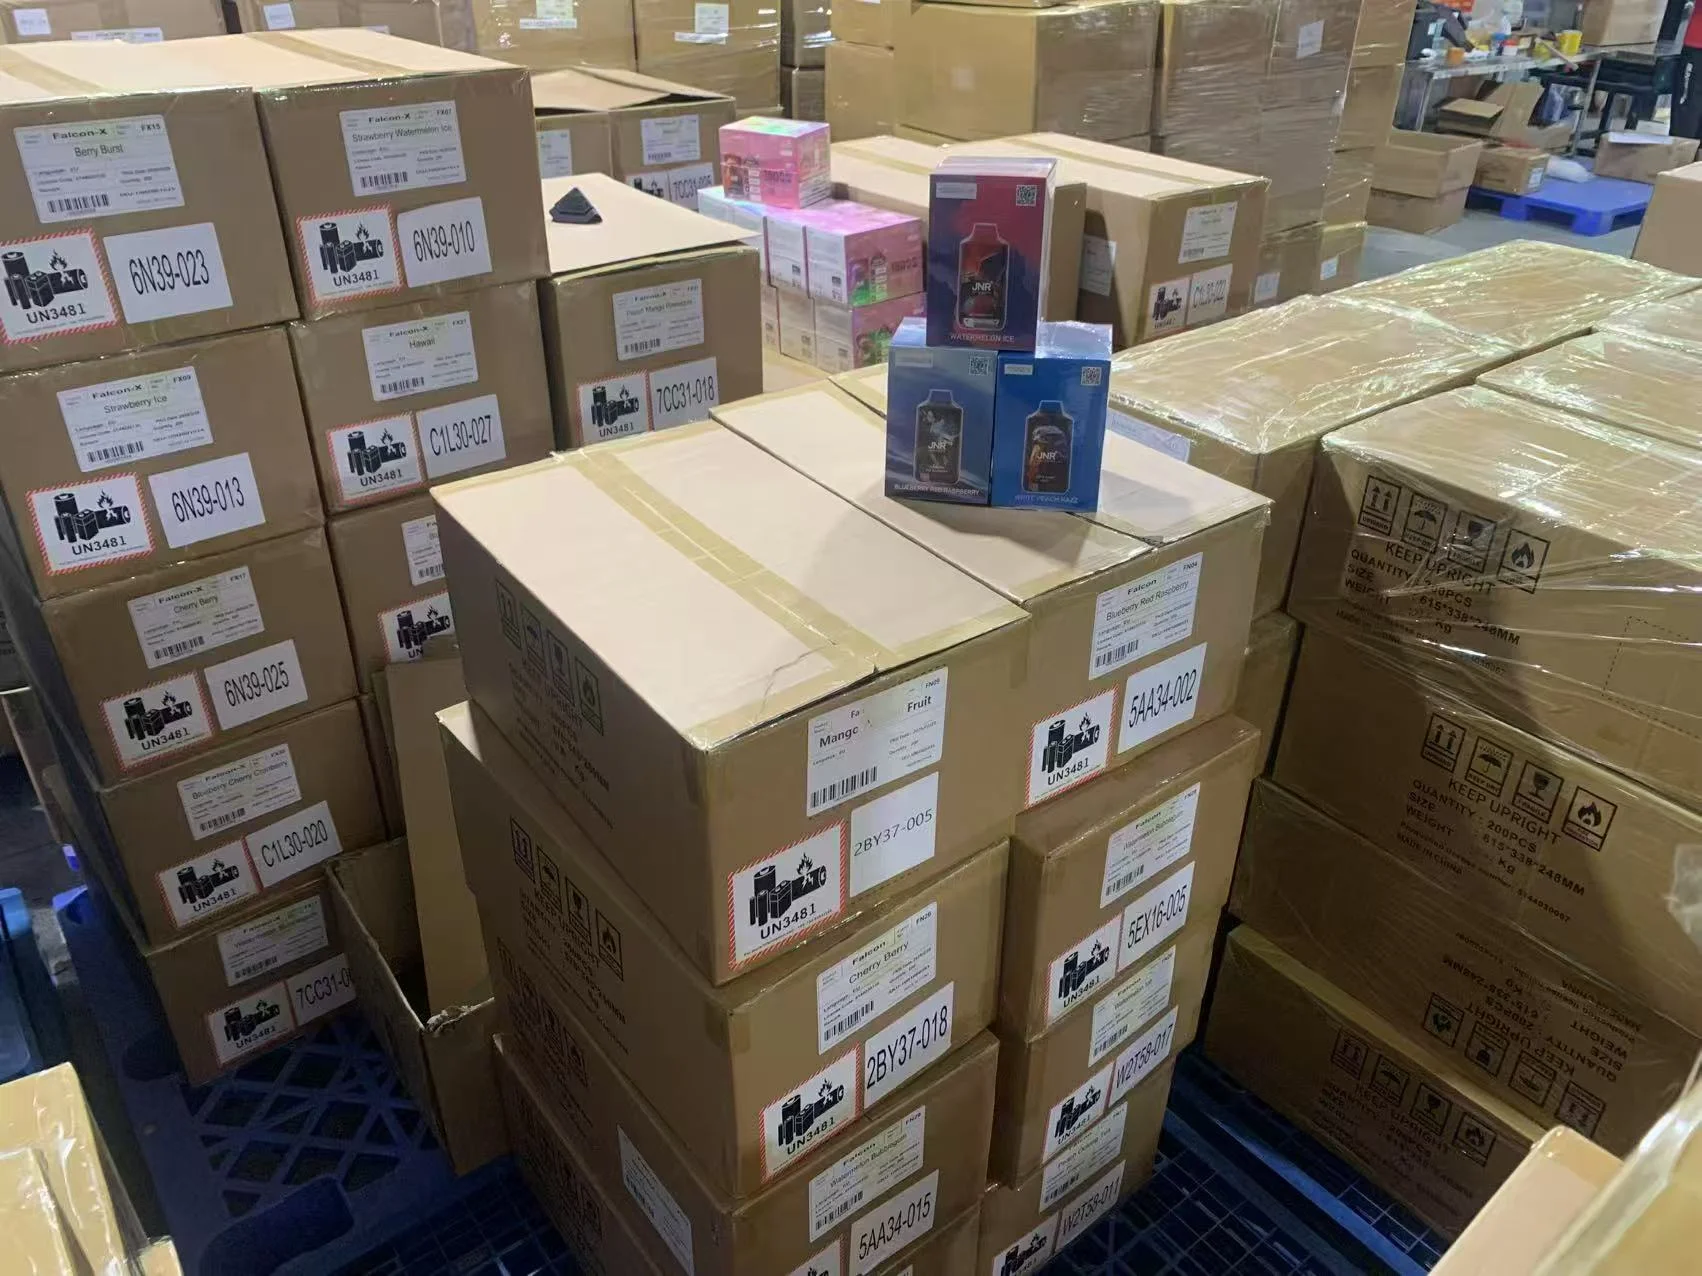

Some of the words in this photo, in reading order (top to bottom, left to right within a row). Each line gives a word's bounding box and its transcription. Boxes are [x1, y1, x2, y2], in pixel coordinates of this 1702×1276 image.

[52, 128, 108, 140] Falcon-X
[352, 130, 394, 143] Strawberry
[395, 125, 440, 138] Watermelon
[74, 146, 99, 158] Berry
[99, 143, 124, 155] Burst
[412, 220, 475, 262] 6N39-010
[129, 249, 210, 295] 6N39-023
[333, 269, 380, 287] UN3481
[971, 281, 992, 292] JNR
[27, 303, 87, 325] UN3481
[949, 333, 1001, 343] WATERMELON
[1002, 334, 1015, 343] ICE
[92, 384, 142, 399] Falcon-X
[103, 397, 151, 414] Strawberry
[153, 393, 168, 404] Ice
[656, 375, 715, 414] 7CC31-018
[429, 414, 494, 456] C1L30-027
[599, 422, 634, 438] UN3481
[927, 441, 947, 450] JNR
[1037, 450, 1056, 461] JNR
[360, 469, 403, 487] UN3481
[894, 484, 929, 493] BLUEBERRY
[943, 487, 980, 497] RASPBERRY
[171, 476, 245, 523] 6N39-013
[71, 535, 127, 556] UN3481
[1385, 541, 1424, 565] KEEP
[1347, 564, 1374, 582] SIZE
[1350, 549, 1413, 581] QUANTITY
[158, 585, 203, 604] Falcon-X
[1106, 603, 1138, 622] Blueberry
[1140, 594, 1155, 609] Red
[1155, 580, 1189, 599] Raspberry
[1127, 578, 1157, 596] Falcon
[173, 600, 199, 614] Cherry
[199, 594, 219, 609] Berry
[224, 661, 290, 707] 6N39-025
[1129, 668, 1197, 729] 5AA34-002
[907, 695, 932, 712] Fruit
[141, 727, 190, 751] UN3481
[1047, 756, 1089, 786] UN3481
[1408, 791, 1436, 812] SIZE
[1412, 779, 1476, 818] QUANTITY
[1487, 820, 1538, 853] 200PCS
[1449, 779, 1487, 803] KEEP
[1489, 799, 1561, 845] UPRIGHT
[261, 819, 328, 868] C1L30-020
[854, 808, 933, 857] 2BY37-005
[1406, 805, 1455, 837] WEIGHT
[1498, 857, 1516, 875] Kg
[192, 888, 237, 913] UN3481
[760, 903, 817, 940] UN3481
[1127, 884, 1187, 949] 5EX16-005
[848, 960, 882, 984] Cherry
[883, 941, 909, 962] Berry
[852, 941, 886, 966] Falcon
[296, 967, 351, 1009] 7CC31-0
[1063, 975, 1100, 1008] UN3481
[235, 1025, 276, 1049] UN3481
[1465, 1002, 1531, 1050] UPRIGHT
[1570, 1020, 1628, 1060] WEIGHT
[866, 1005, 948, 1090] 2BY37-018
[1116, 1023, 1174, 1089] W2T58-017
[1534, 1046, 1575, 1077] KEEP
[1546, 1034, 1618, 1082] QUANTITY
[1591, 1045, 1624, 1072] SIZE
[786, 1116, 835, 1155] UN3481
[1057, 1114, 1091, 1145] UN3481
[859, 1192, 931, 1261] 5AA34-015
